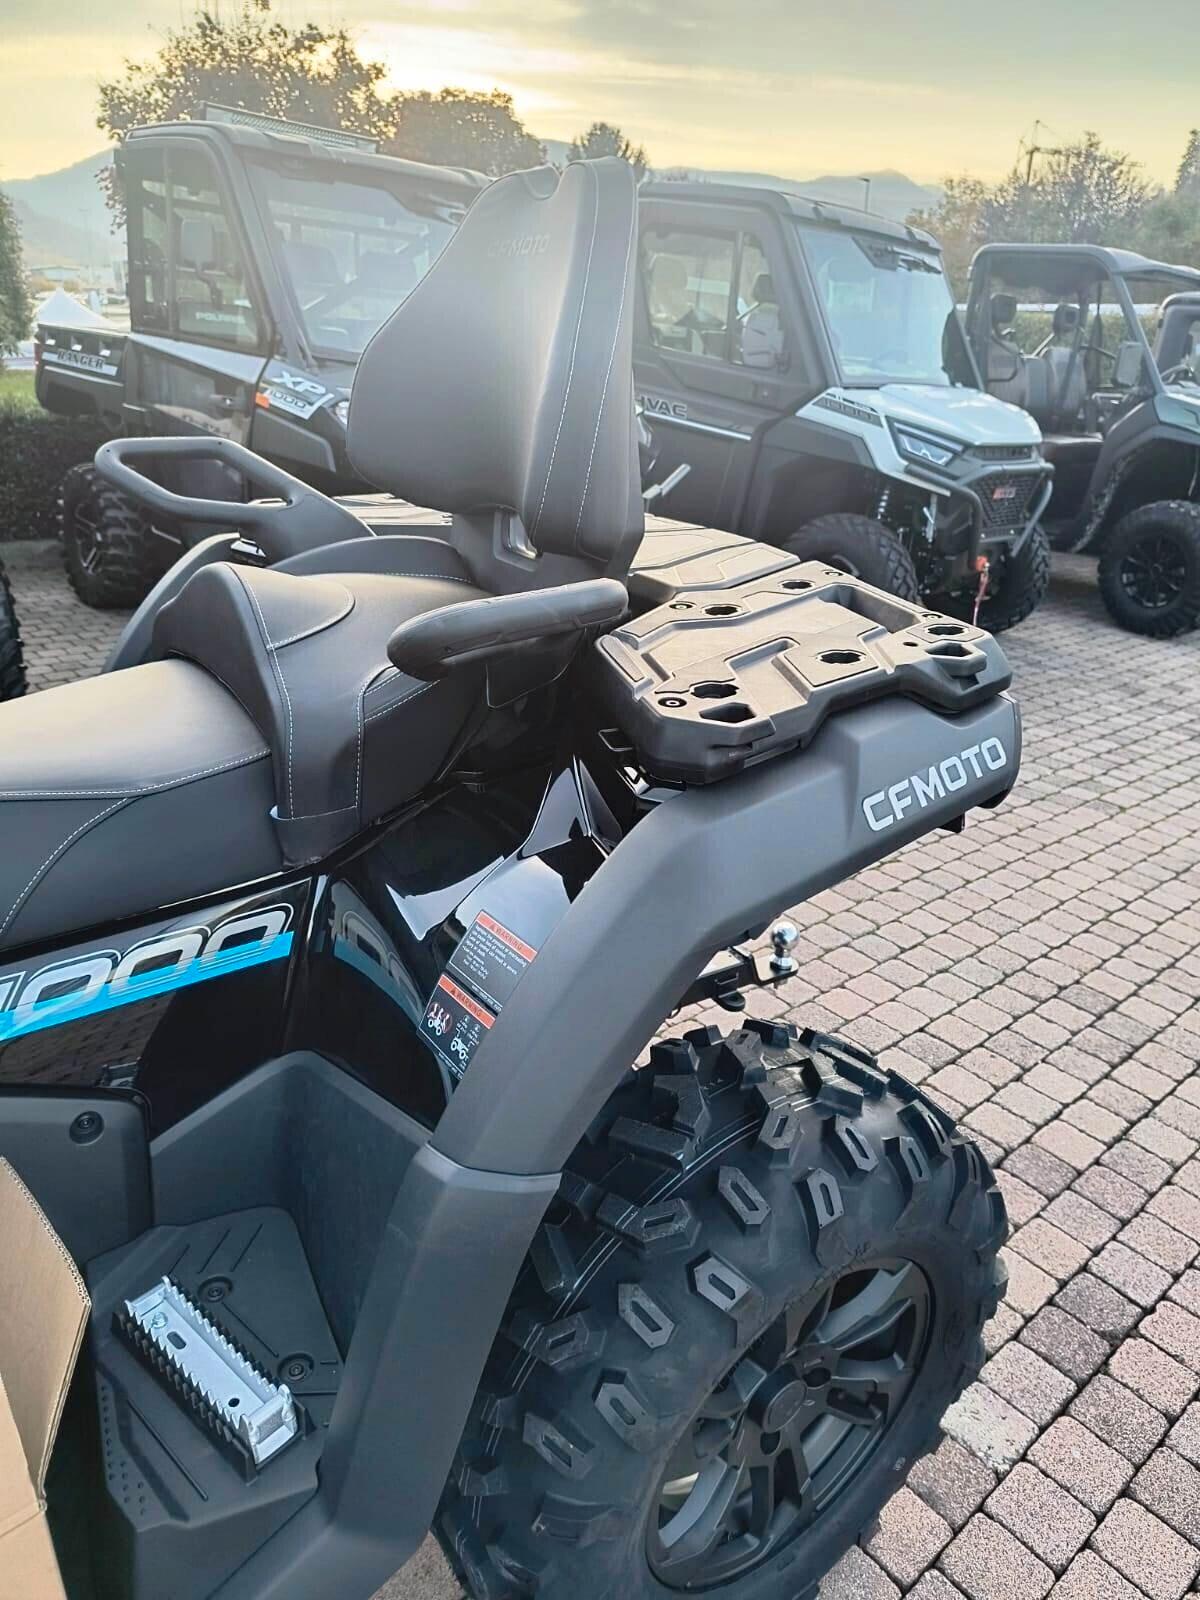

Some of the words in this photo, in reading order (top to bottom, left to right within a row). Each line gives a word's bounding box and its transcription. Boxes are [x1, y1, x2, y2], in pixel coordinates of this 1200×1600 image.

[57, 350, 105, 369] RANGER
[271, 370, 326, 395] XP
[263, 388, 306, 409] 1000
[862, 737, 1007, 832] CFMOTO
[495, 926, 523, 950] WARNING
[455, 990, 481, 1017] WARNING
